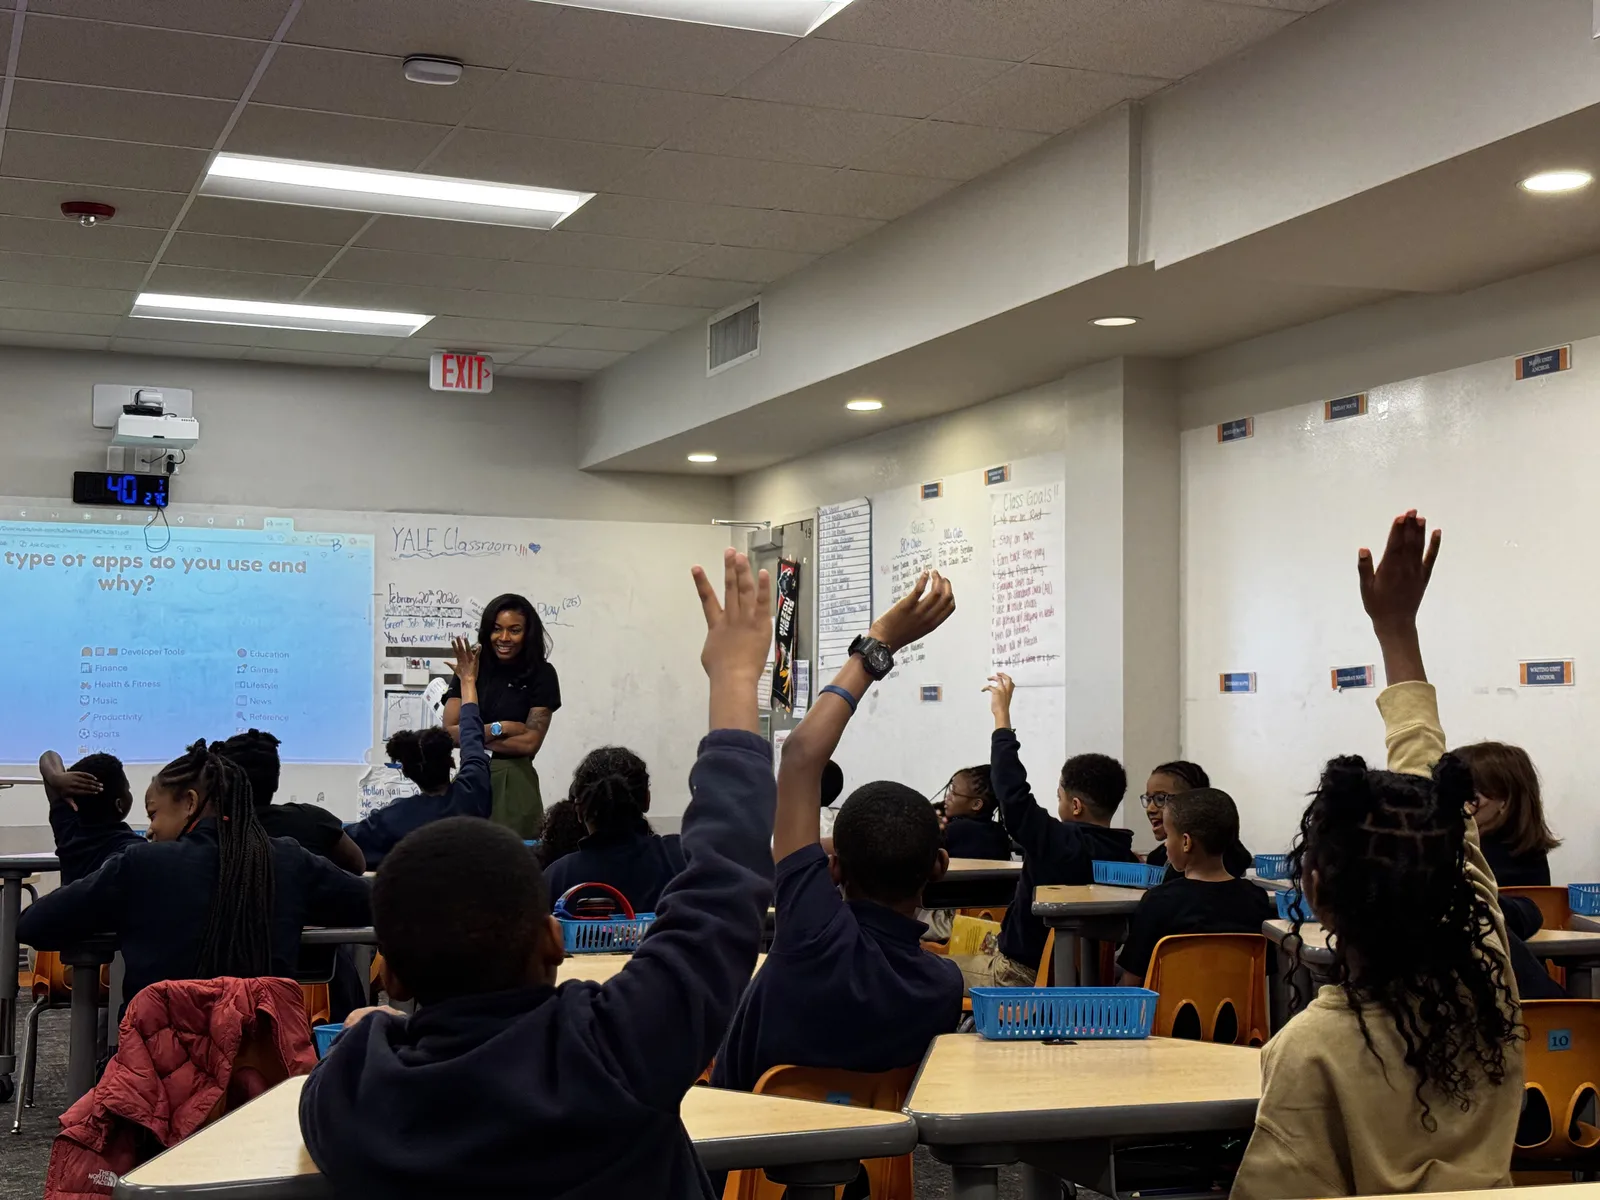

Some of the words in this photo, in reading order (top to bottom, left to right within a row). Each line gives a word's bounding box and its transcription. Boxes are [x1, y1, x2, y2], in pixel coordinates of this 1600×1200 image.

[442, 354, 486, 390] EXIT
[107, 475, 137, 504] 40
[1003, 493, 1024, 511] Class
[392, 527, 437, 551] YALE
[804, 527, 812, 539] 19
[4, 551, 56, 570] type
[92, 555, 143, 572] apps
[182, 558, 221, 574] you
[227, 559, 263, 572] use
[268, 560, 307, 573] and
[98, 574, 155, 596] why?
[784, 600, 795, 636] TIGERS
[121, 648, 162, 656] Developer
[250, 650, 289, 658] Education
[250, 665, 278, 674] Games
[132, 680, 160, 688] Fitness
[246, 681, 278, 690] Lifestyle
[249, 713, 289, 721] Reference
[1552, 1035, 1569, 1046] 10
